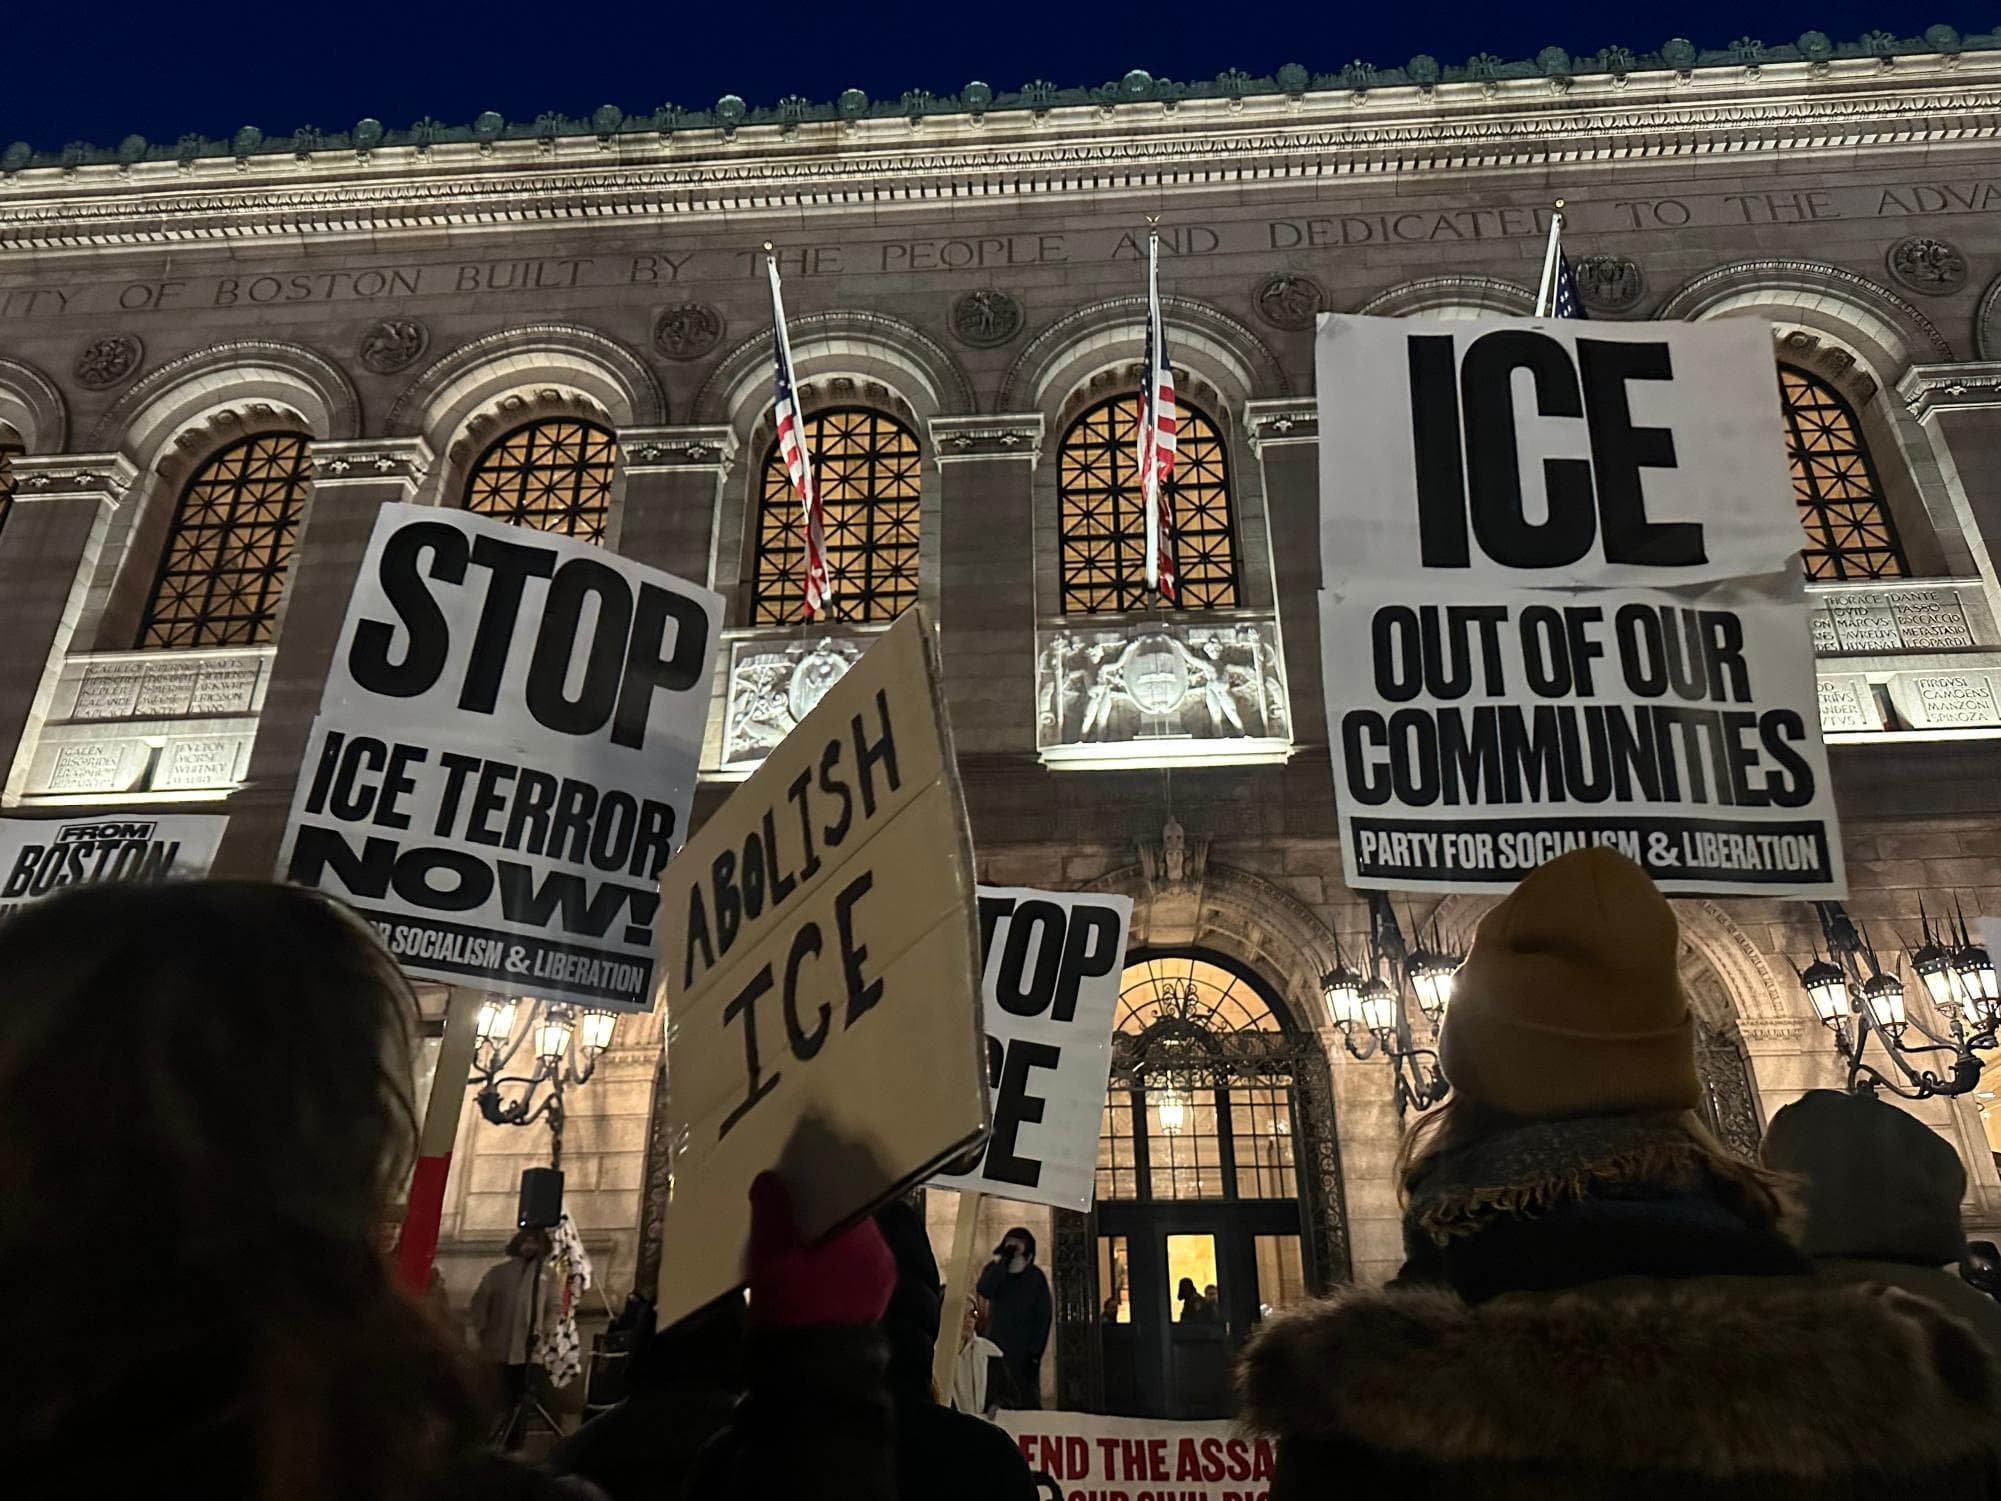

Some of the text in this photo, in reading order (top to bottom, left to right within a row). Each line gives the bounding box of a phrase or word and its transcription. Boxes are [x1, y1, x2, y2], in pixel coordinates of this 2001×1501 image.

[119, 281, 187, 310] OF
[213, 267, 422, 306] BOSTON
[456, 259, 595, 292] BUILT
[629, 253, 696, 283] BY
[736, 247, 844, 277] THE
[880, 235, 1069, 272] PEOPLE
[1111, 226, 1219, 258] AND
[1269, 207, 1568, 250] DEDICATED
[1615, 200, 1692, 229] TO
[1724, 191, 1842, 224] THE
[1407, 329, 1709, 569] ICE
[1830, 594, 1884, 605] HORACE
[1834, 607, 1868, 617] OVID
[1890, 592, 1940, 602] DANTE
[1894, 602, 1940, 613] TASSO
[348, 520, 709, 750] STOP
[1371, 603, 1753, 703] OUT OF OUR
[1902, 625, 1966, 636] METASTASIO
[1906, 637, 1967, 648] LEOPARDI
[1928, 700, 1990, 711] MANZONI
[1341, 705, 1817, 808] COMMUNITIES
[60, 824, 151, 841] FROM
[304, 731, 676, 880] ICE TERROR
[0, 840, 180, 897] BOSTON
[684, 689, 901, 991] ABOLISH
[1360, 830, 1438, 867] PARTY
[1443, 832, 1495, 870] FOR
[1648, 831, 1682, 867] &
[1682, 831, 1820, 871] LIBERATION
[287, 824, 661, 947] NOW!
[392, 926, 504, 972] SOCIALISM
[504, 945, 532, 975] &
[534, 949, 645, 994] LIBERATION
[719, 870, 885, 1143] ICE
[1019, 1436, 1274, 1482] END THE ASSA
